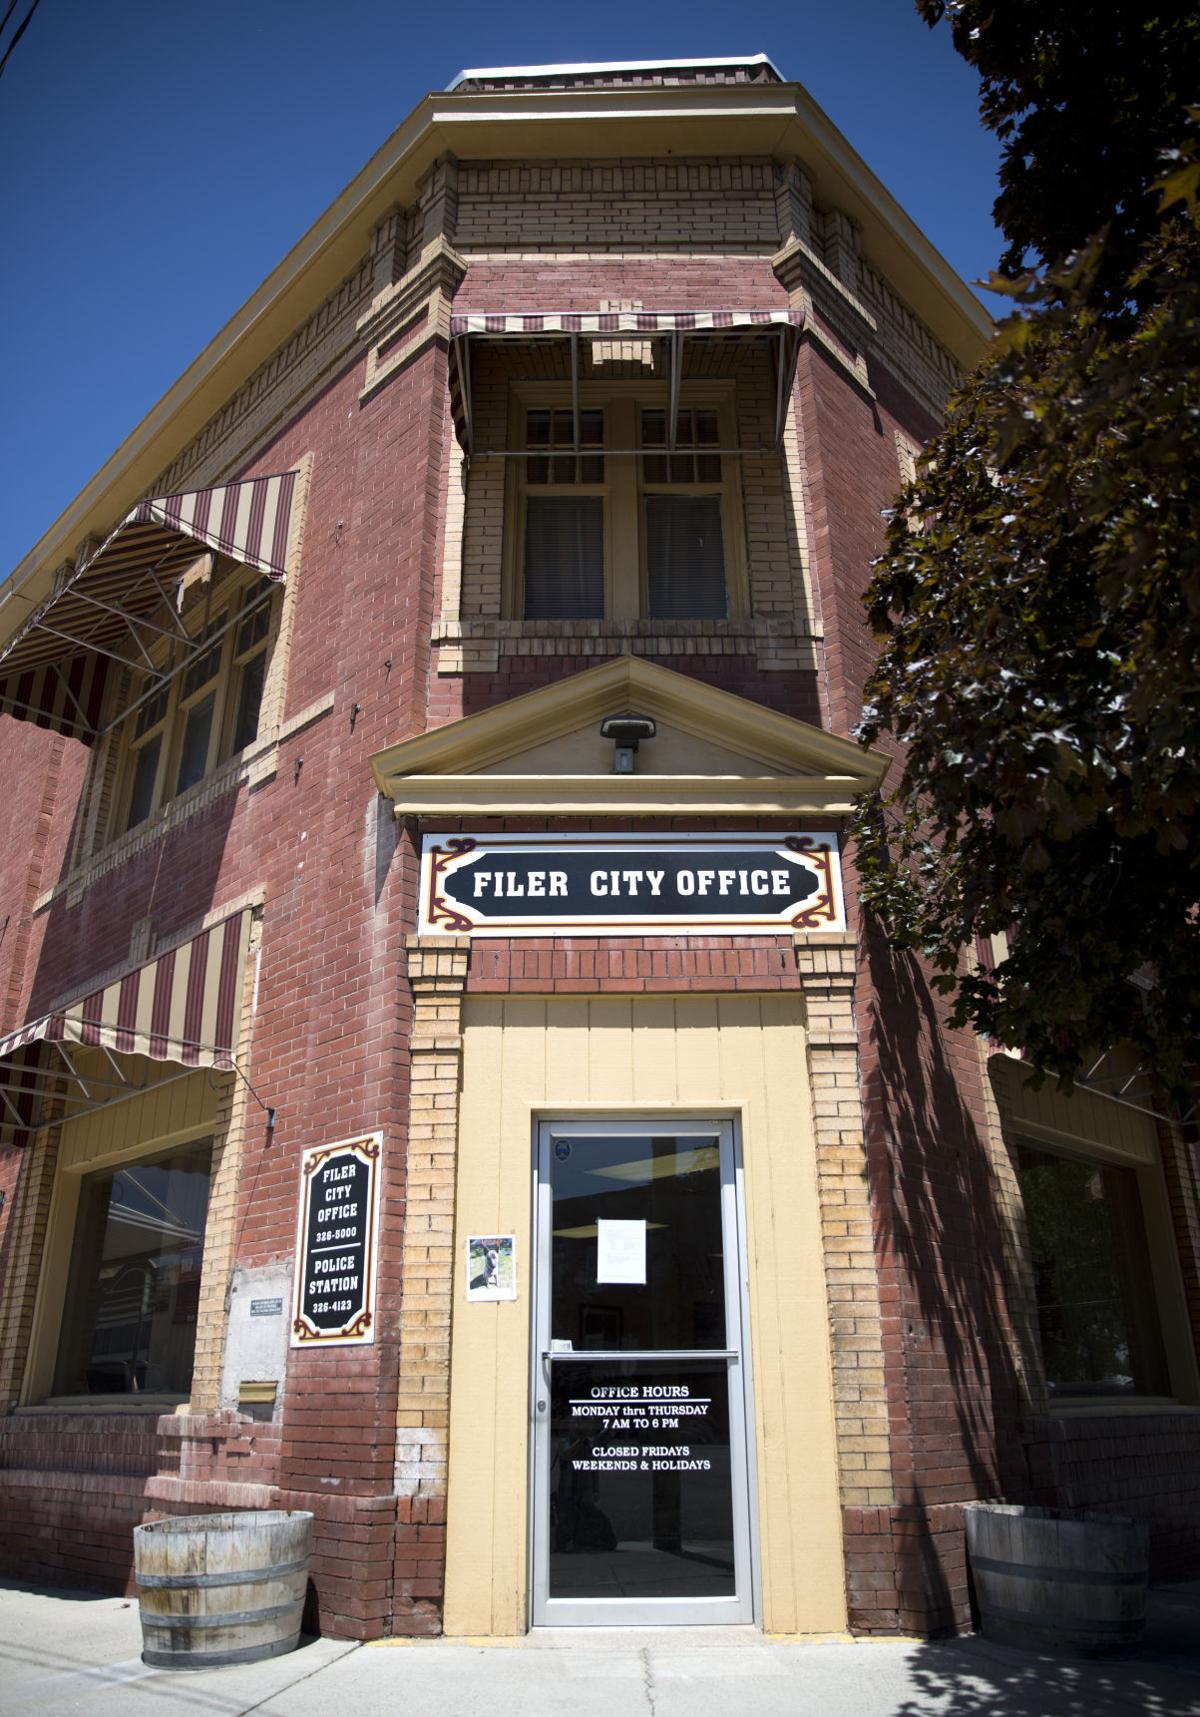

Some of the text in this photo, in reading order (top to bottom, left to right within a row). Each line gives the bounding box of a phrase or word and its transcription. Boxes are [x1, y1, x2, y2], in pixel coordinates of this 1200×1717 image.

[473, 869, 791, 897] FILER CITY OFFICE
[323, 1164, 356, 1183] FILER
[325, 1184, 352, 1202] CITY
[317, 1203, 358, 1223] OFFICE
[316, 1226, 357, 1242] 326-5000
[314, 1255, 355, 1274] POLICE
[309, 1275, 359, 1295] STATION
[312, 1299, 352, 1314] 326-4123
[590, 1385, 690, 1398] OFFICE HOURS
[571, 1405, 709, 1417] MONDAY thru THURSDAY
[602, 1418, 679, 1429] 7 AM TO 6 PM
[592, 1446, 690, 1457] CLOSED FRIDAYS
[572, 1460, 711, 1471] WEEKENDS & HOLIDAYS
